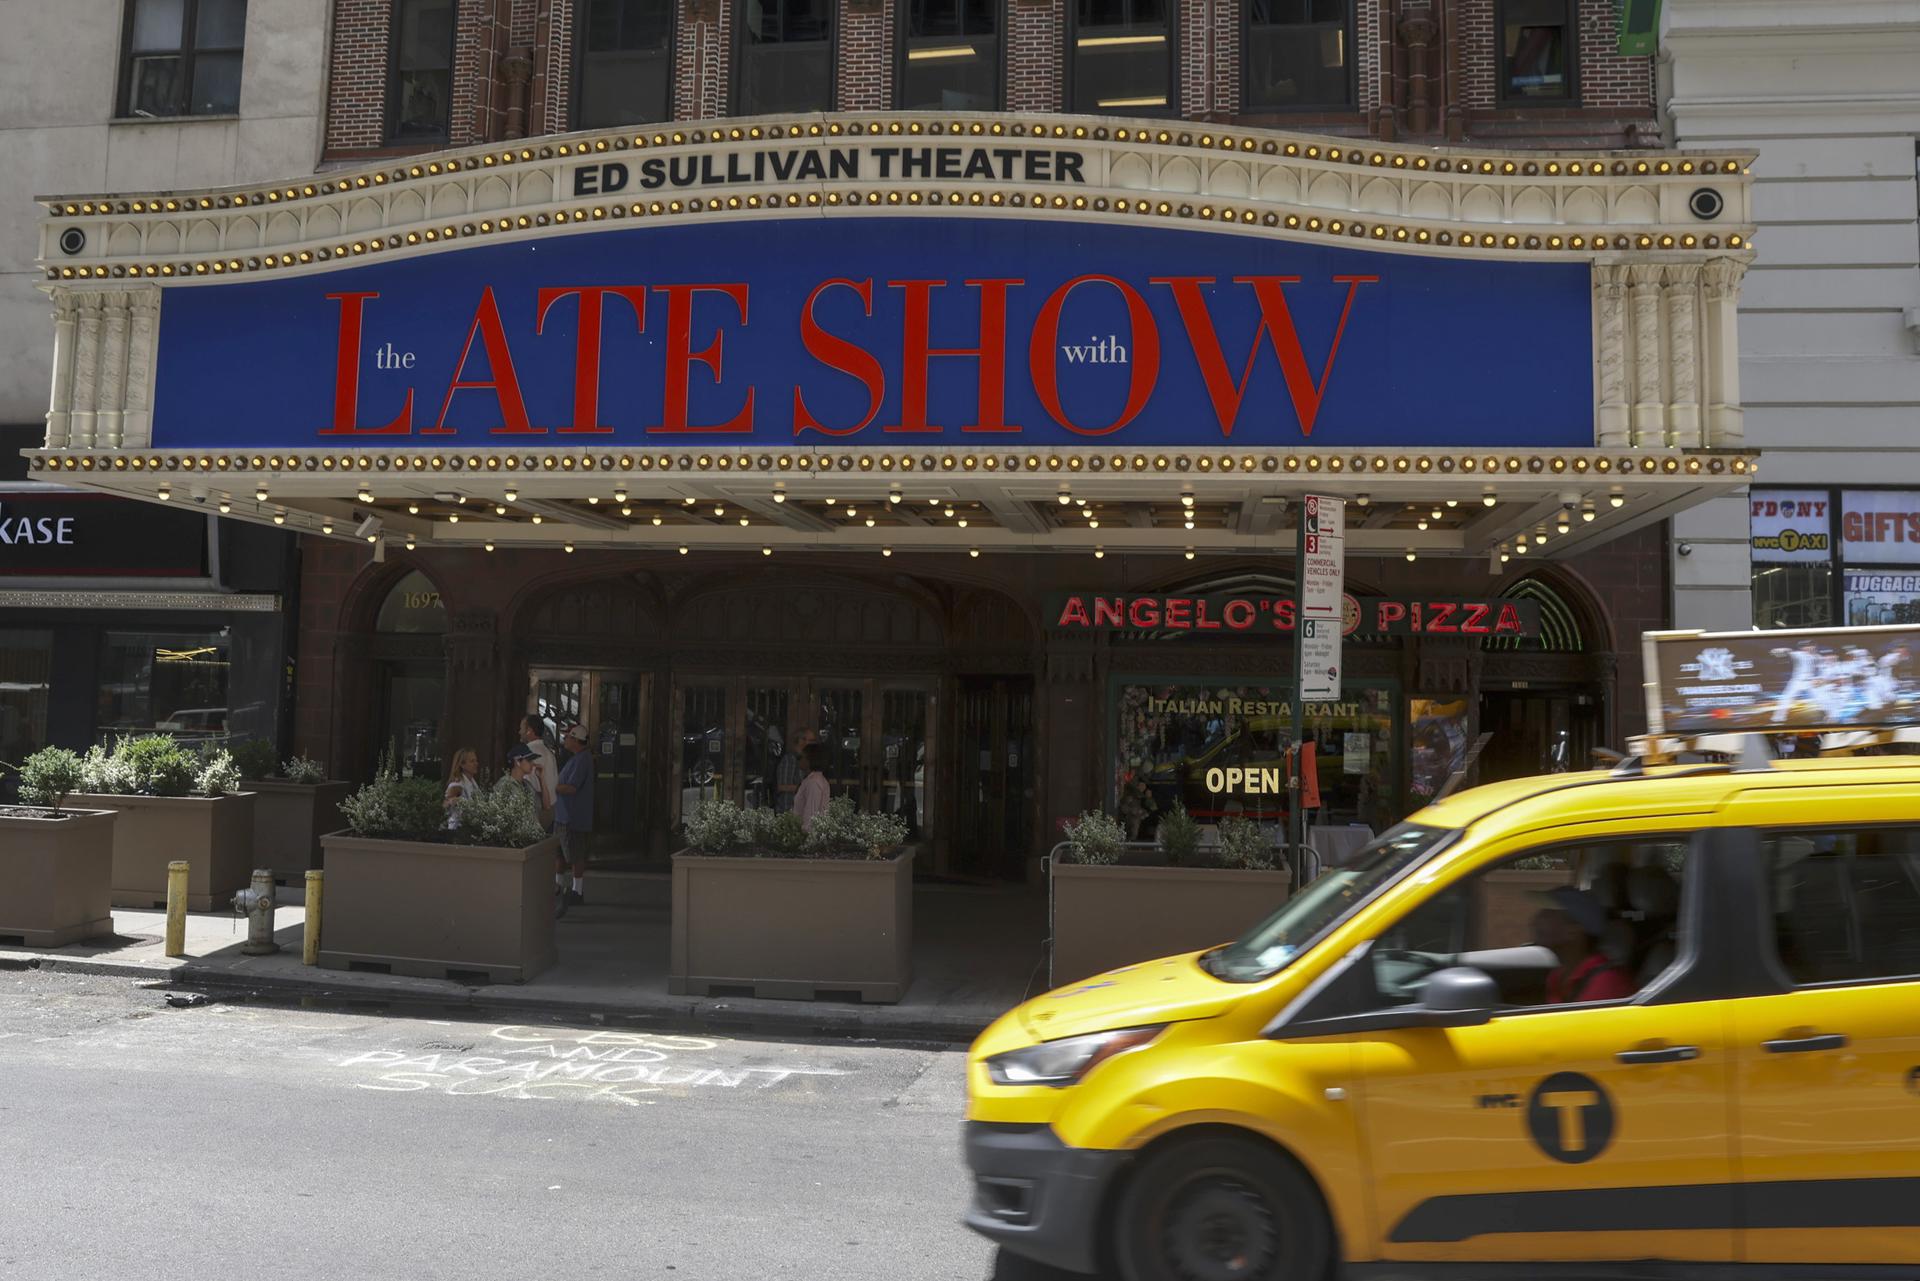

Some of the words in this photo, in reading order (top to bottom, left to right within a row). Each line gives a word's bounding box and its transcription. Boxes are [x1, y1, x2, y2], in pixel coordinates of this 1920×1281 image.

[573, 162, 628, 197] ED
[640, 148, 859, 190] SULLIVAN
[871, 147, 1085, 183] THEATER
[318, 283, 755, 436] LATE
[793, 273, 1381, 438] SHOW
[375, 343, 417, 370] the
[1062, 334, 1128, 366] with
[0, 517, 75, 545] KASE
[1843, 511, 1920, 544] GIFTS
[1308, 536, 1316, 553] 3
[1307, 558, 1336, 567] COMMERCIAL
[1307, 567, 1329, 576] VEHICLES
[1329, 568, 1340, 577] ONLY
[403, 594, 439, 609] 1697
[1058, 597, 1296, 630] ANGELO'S
[1377, 602, 1521, 633] PIZZA
[1305, 621, 1313, 638] 6
[1229, 698, 1359, 716] RESTARANT
[1206, 767, 1279, 794] OPEN
[491, 1025, 718, 1050] CBS
[503, 1045, 668, 1062] AND
[337, 1051, 860, 1089] PARAMOUNT
